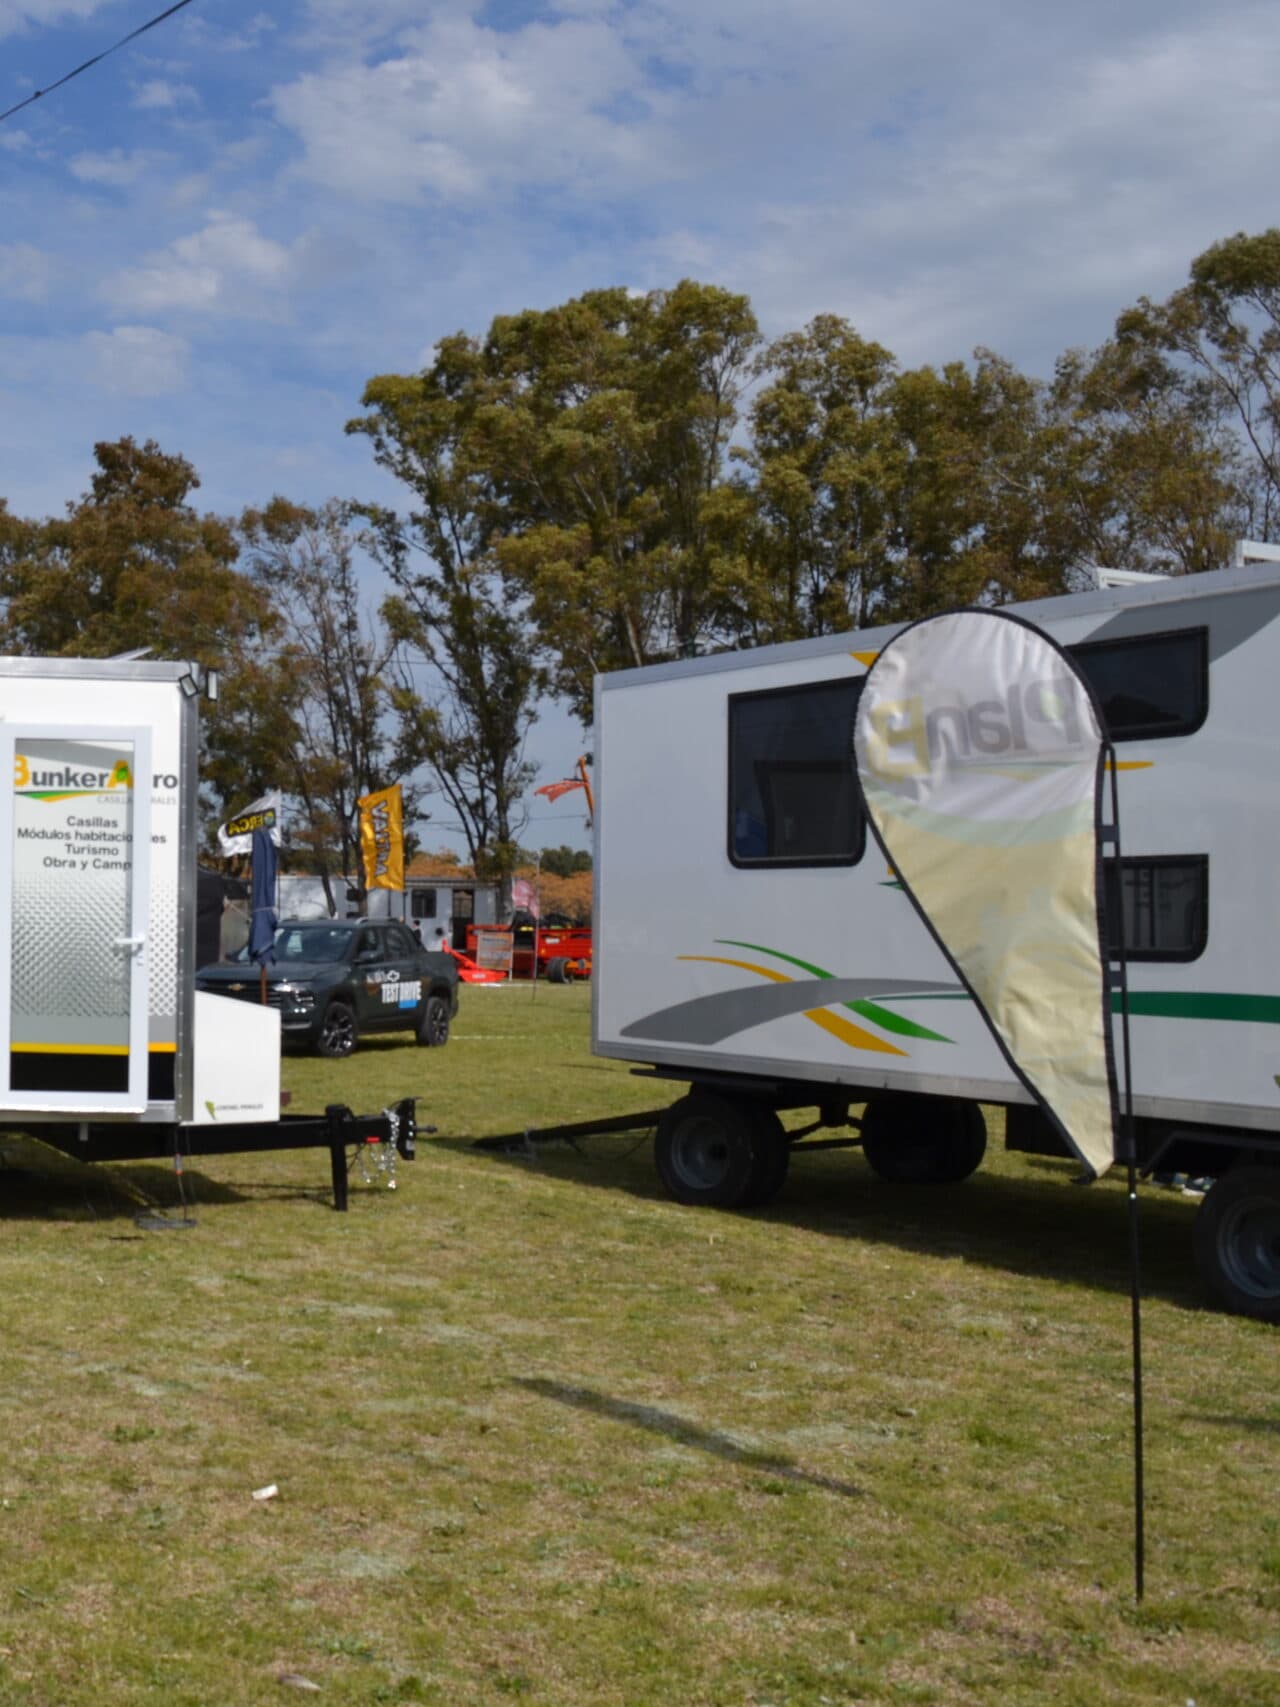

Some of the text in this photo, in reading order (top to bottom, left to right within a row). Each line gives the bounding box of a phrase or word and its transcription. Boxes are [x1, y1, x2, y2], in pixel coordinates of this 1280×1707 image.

[14, 754, 178, 790] BunkerAro
[66, 815, 119, 829] Casillas
[17, 826, 71, 841] Módulos
[65, 843, 120, 857] Turismo
[42, 855, 134, 873] Obra y Camp
